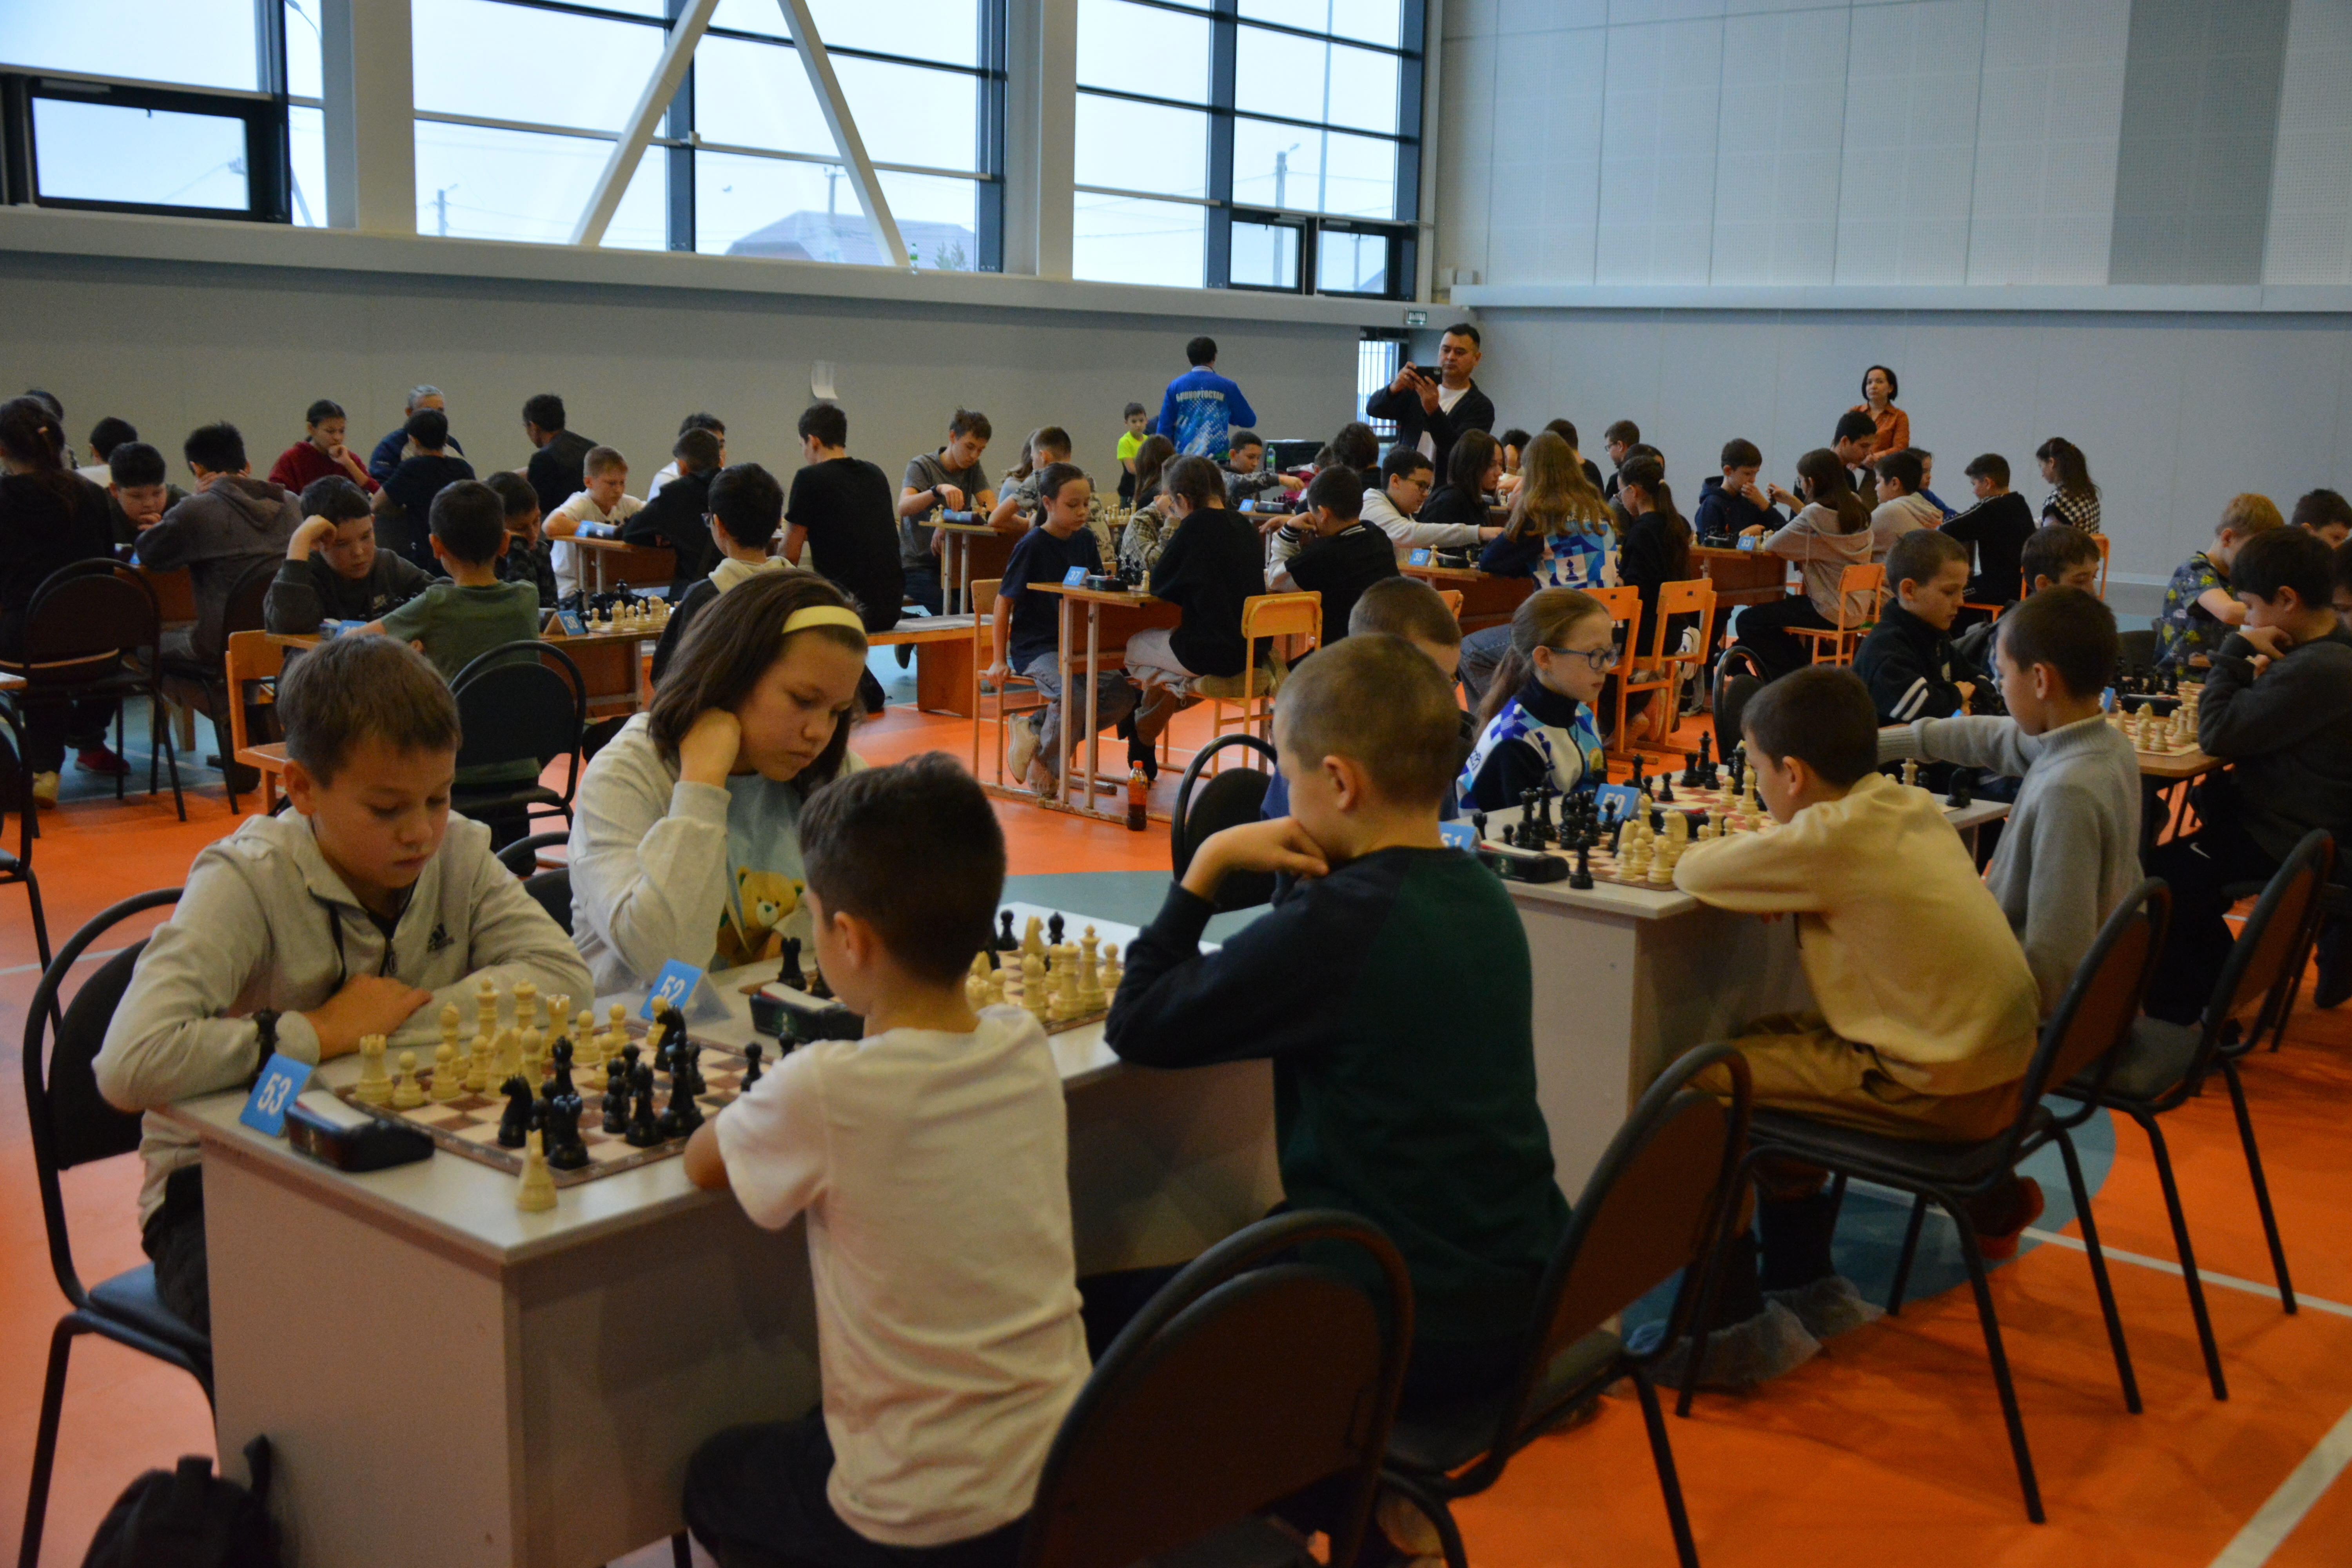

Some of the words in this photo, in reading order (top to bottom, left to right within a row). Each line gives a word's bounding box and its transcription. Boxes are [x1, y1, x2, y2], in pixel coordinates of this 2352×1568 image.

[1176, 390, 1224, 402] БАШКОРТОСТАН
[1068, 571, 1081, 581] 37
[564, 616, 579, 629] 38
[1601, 792, 1626, 814] 50
[660, 975, 685, 1007] 52
[258, 1073, 292, 1115] 53
